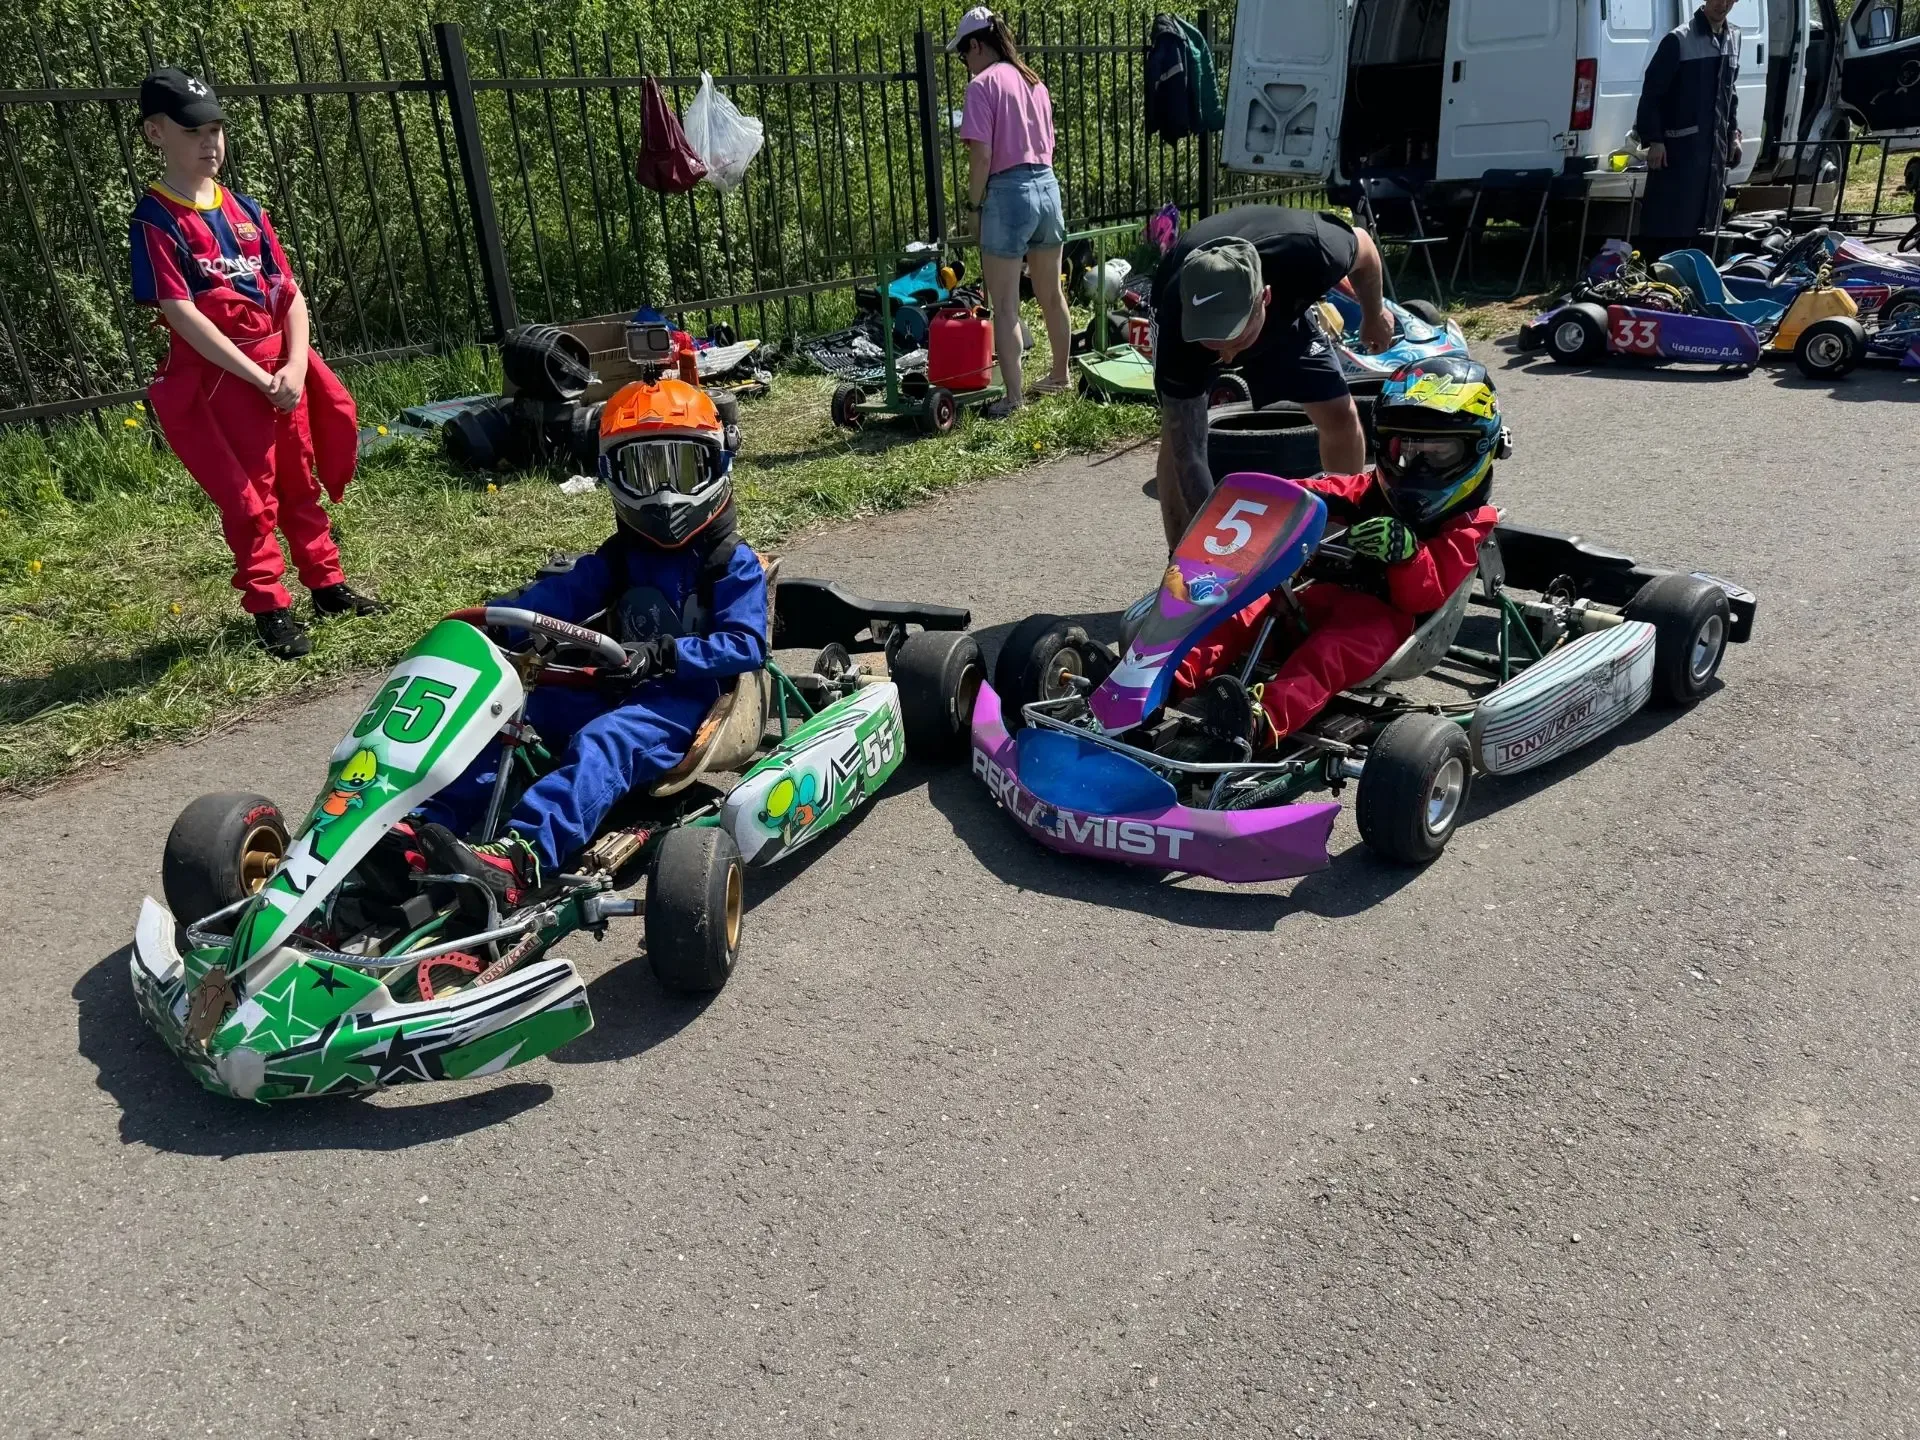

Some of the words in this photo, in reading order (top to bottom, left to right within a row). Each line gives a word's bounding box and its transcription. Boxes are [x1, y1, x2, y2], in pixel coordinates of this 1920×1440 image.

[1614, 319, 1658, 348] 33
[1203, 498, 1269, 556] 5
[352, 675, 458, 744] 55
[862, 719, 896, 779] 55
[243, 804, 277, 826] VEGA
